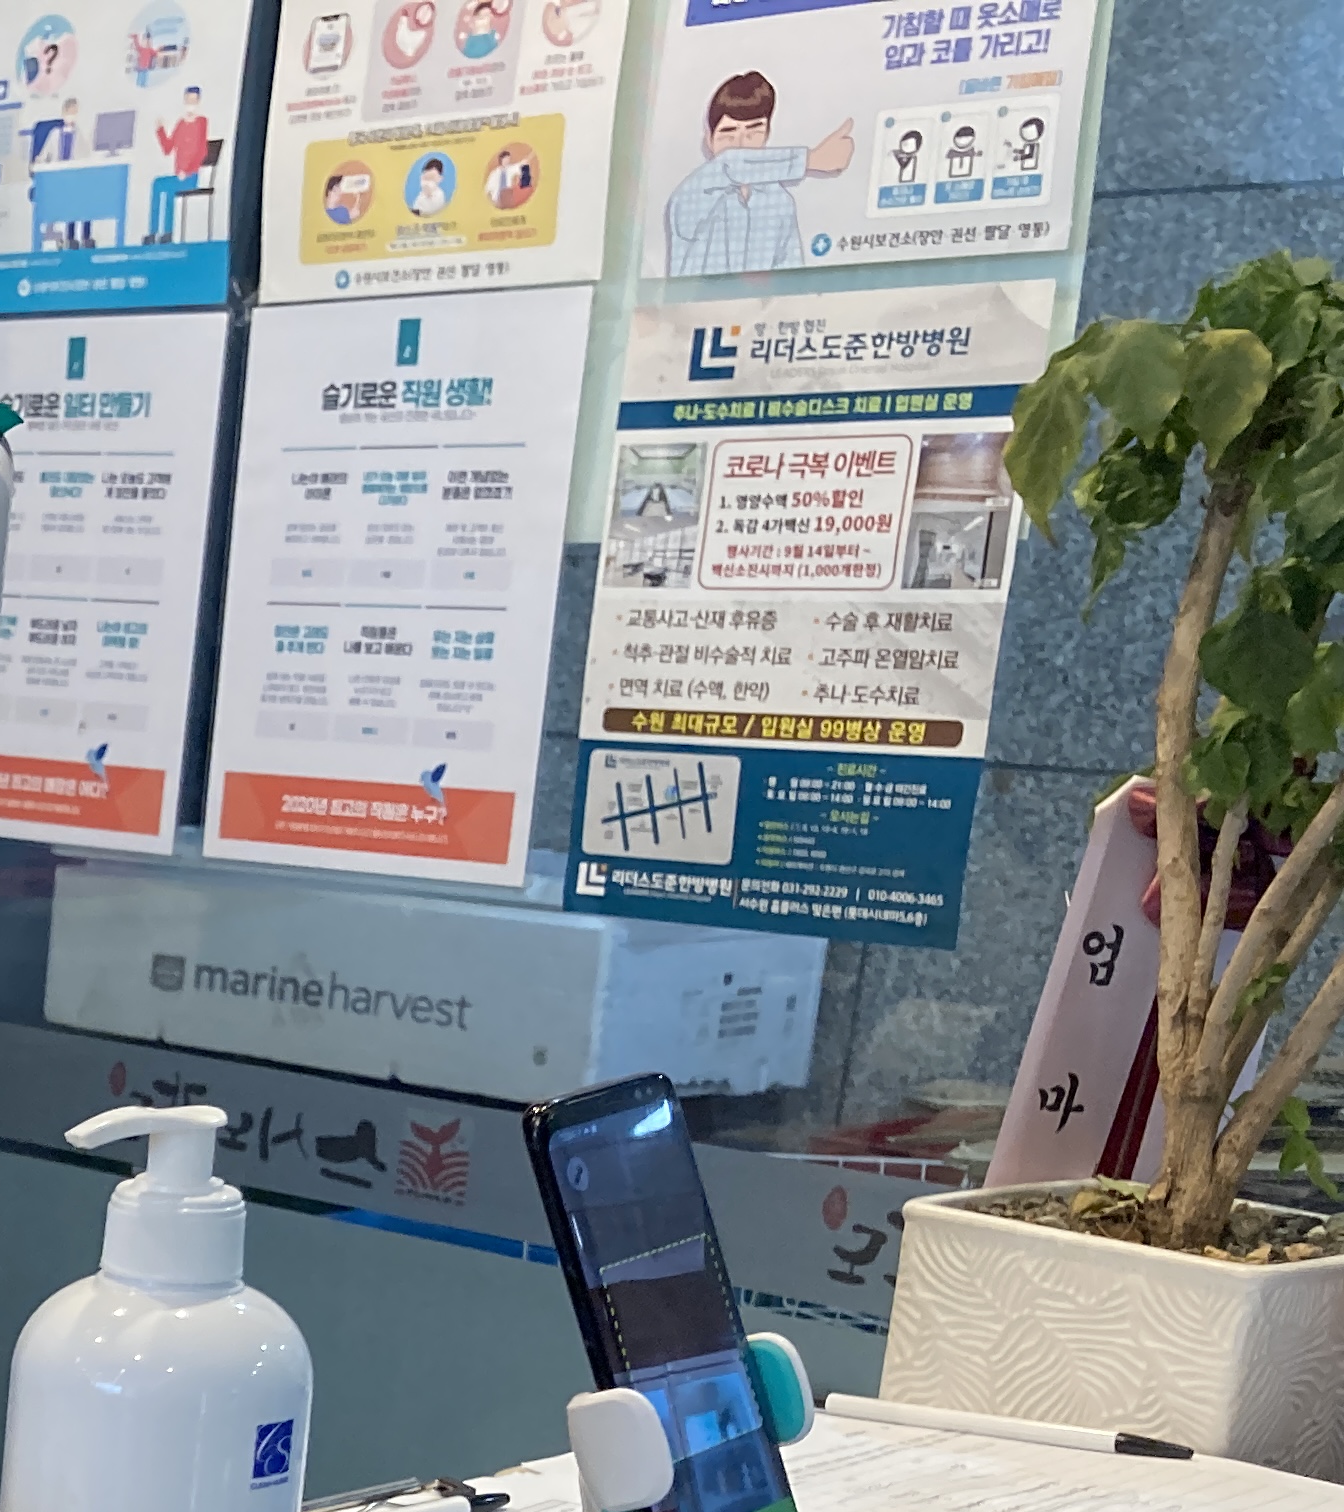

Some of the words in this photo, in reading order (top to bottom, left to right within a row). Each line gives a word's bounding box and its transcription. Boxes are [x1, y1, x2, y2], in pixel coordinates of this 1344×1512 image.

[885, 42, 925, 71] 입과
[979, 30, 1050, 59] 가리고!
[321, 382, 397, 410] 슬기로운
[723, 453, 785, 480] 코로나
[789, 453, 830, 479] 극복
[834, 451, 897, 477] 이벤트
